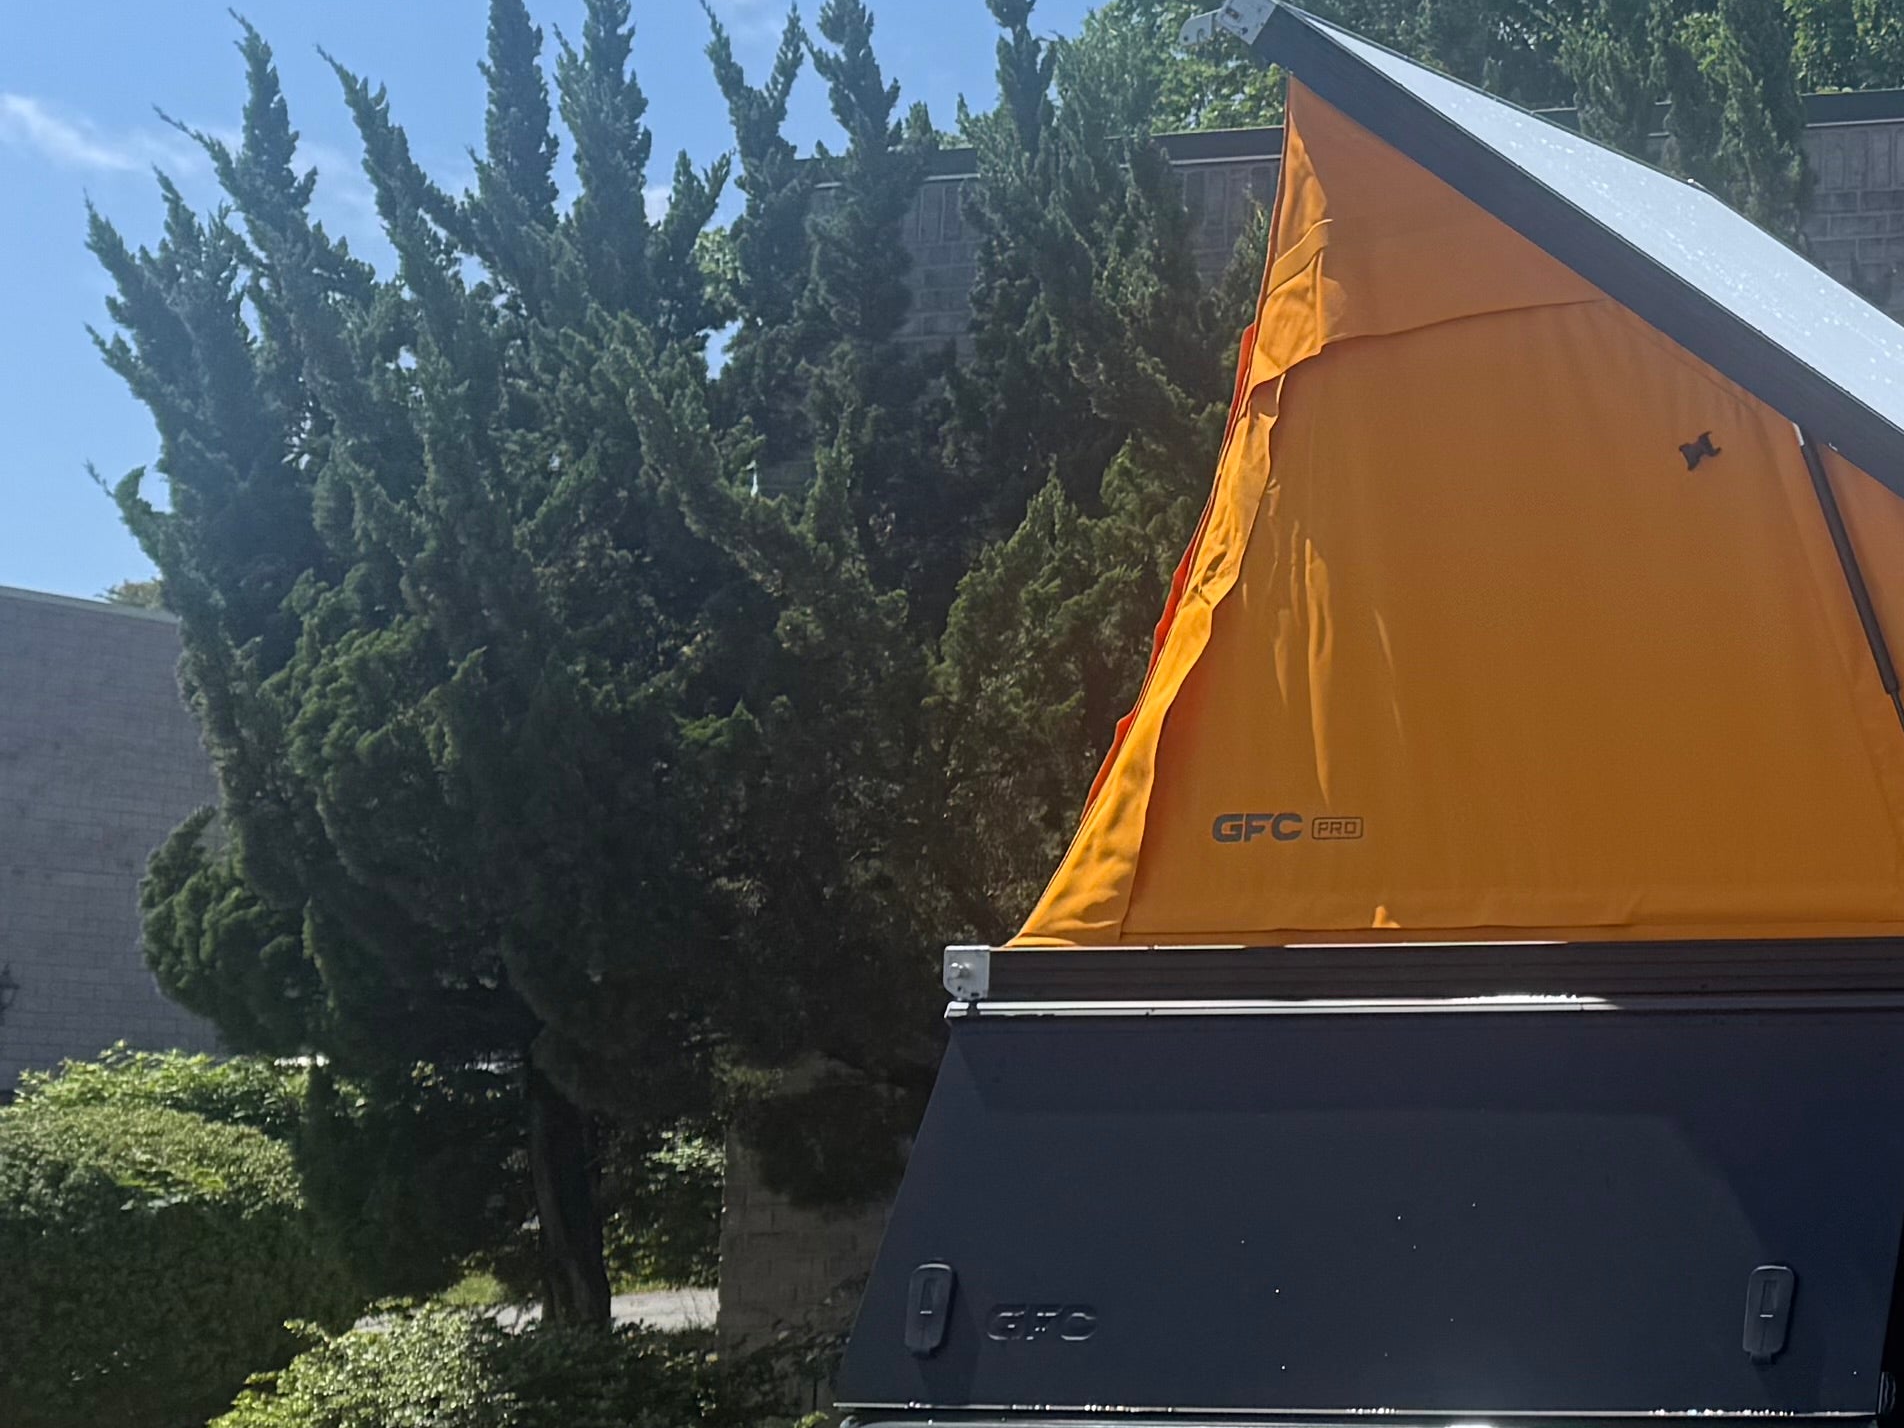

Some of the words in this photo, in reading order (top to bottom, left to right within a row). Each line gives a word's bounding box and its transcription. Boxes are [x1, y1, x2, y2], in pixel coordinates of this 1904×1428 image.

[1211, 812, 1303, 843] GFC
[1316, 821, 1358, 837] PRO
[986, 1303, 1098, 1342] GFC
